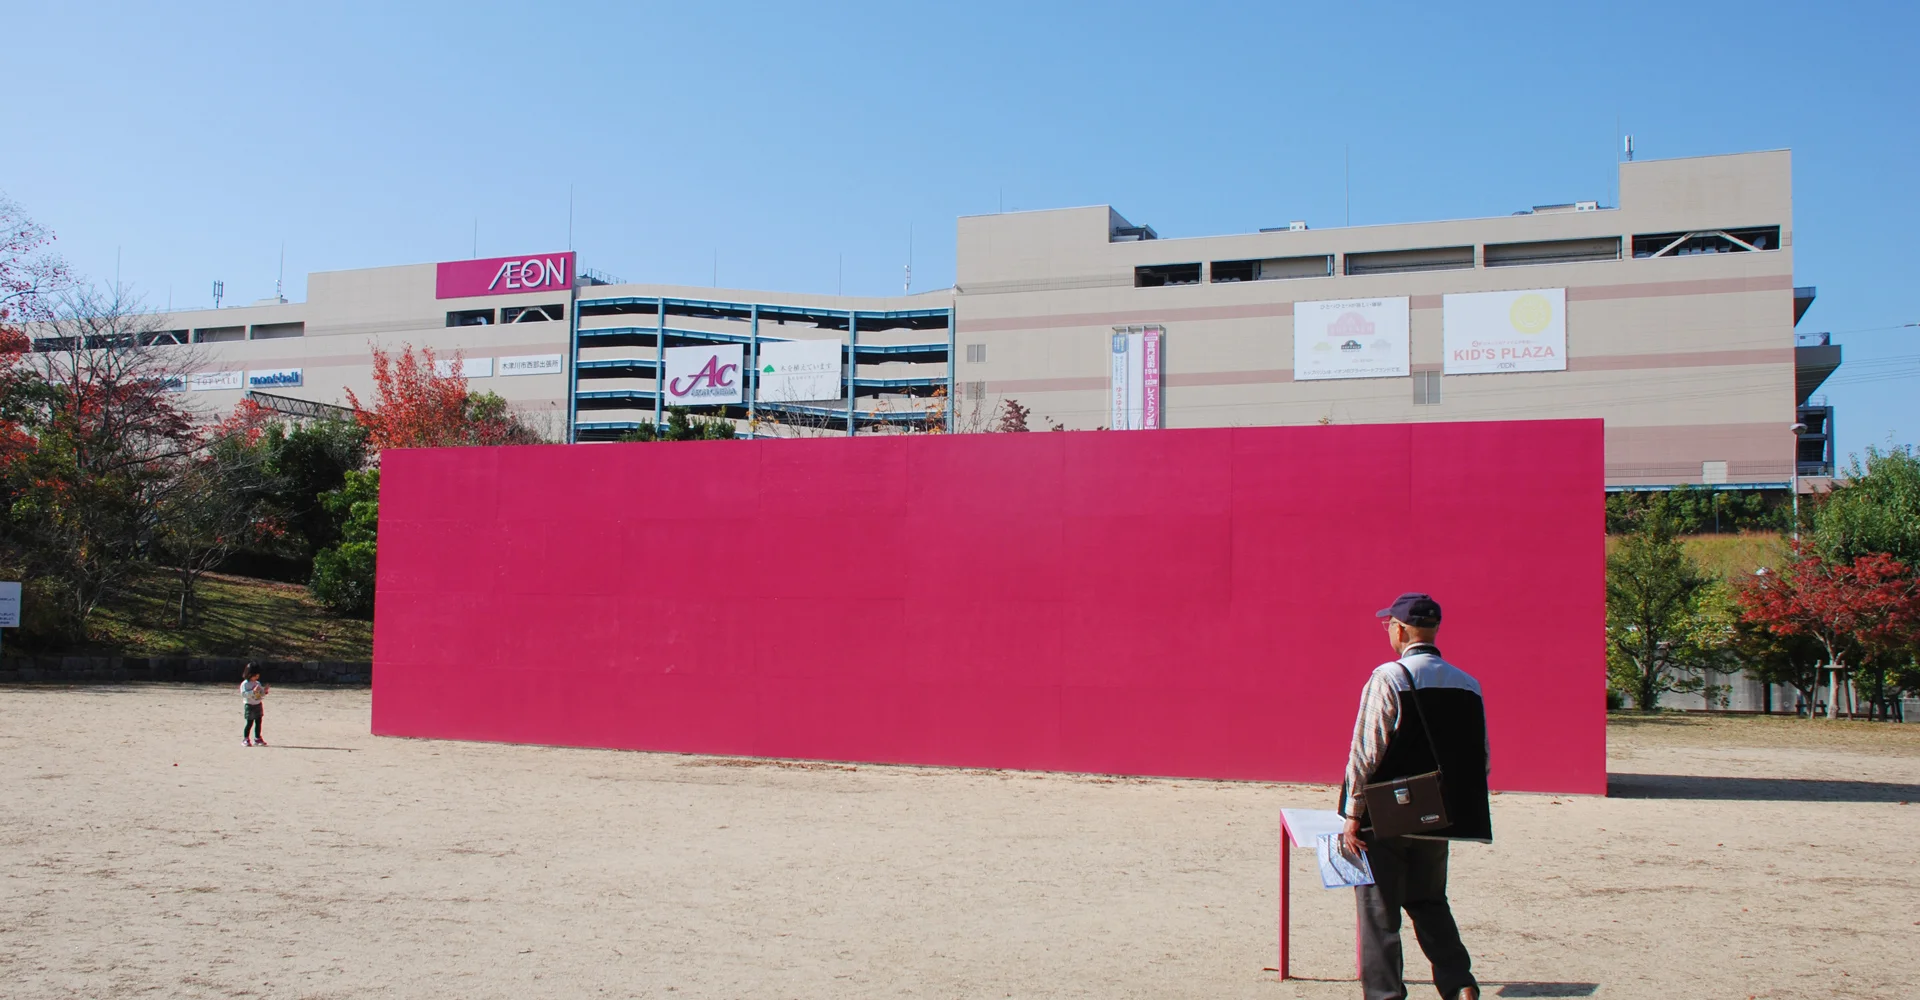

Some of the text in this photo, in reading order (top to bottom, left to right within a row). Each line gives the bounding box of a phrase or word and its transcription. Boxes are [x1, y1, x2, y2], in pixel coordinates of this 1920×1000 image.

[1453, 346, 1555, 361] KID'S PLAZA
[502, 360, 559, 371] 木津川市西部出張所
[779, 362, 833, 373] 木を植えています
[196, 376, 238, 386] TOPVALU
